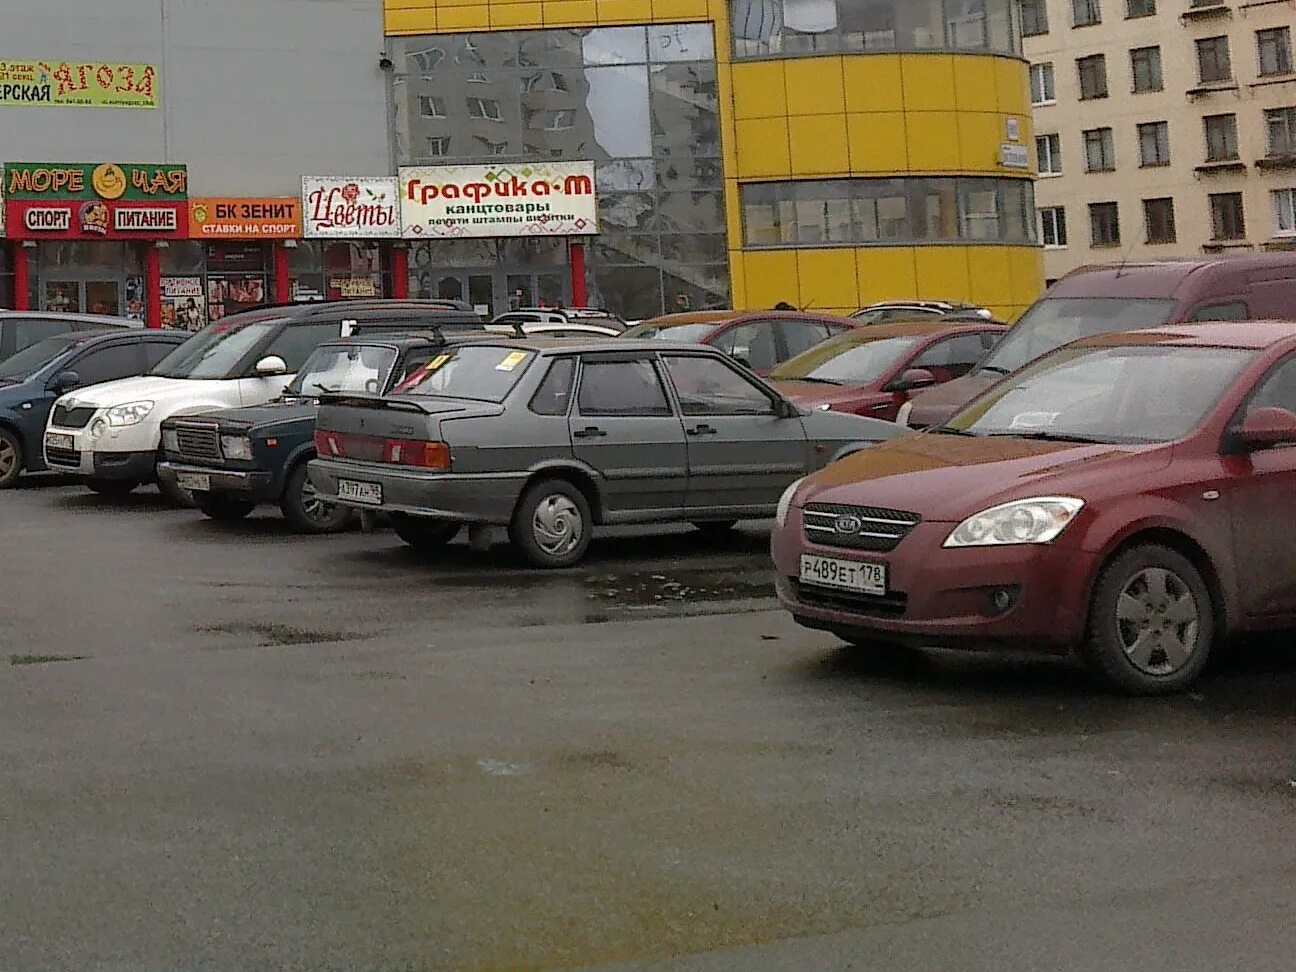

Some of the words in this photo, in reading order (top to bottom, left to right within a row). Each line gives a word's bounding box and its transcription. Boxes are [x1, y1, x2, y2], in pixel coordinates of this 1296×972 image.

[9, 168, 85, 193] МОРЕ
[132, 168, 187, 194] ЧАЯ
[215, 204, 239, 219] БК
[241, 204, 294, 219] ЗЕНИТ
[309, 186, 395, 231] Цветы
[446, 203, 550, 216] канцтовары
[27, 210, 69, 226] СПОРТ
[117, 210, 175, 227] ПИТАНИЕ
[428, 217, 469, 226] печати
[472, 216, 523, 225] штампы
[202, 224, 243, 234] СТАВКИ
[245, 225, 260, 234] НА
[262, 224, 297, 234] СПОРТ
[860, 564, 881, 581] 178
